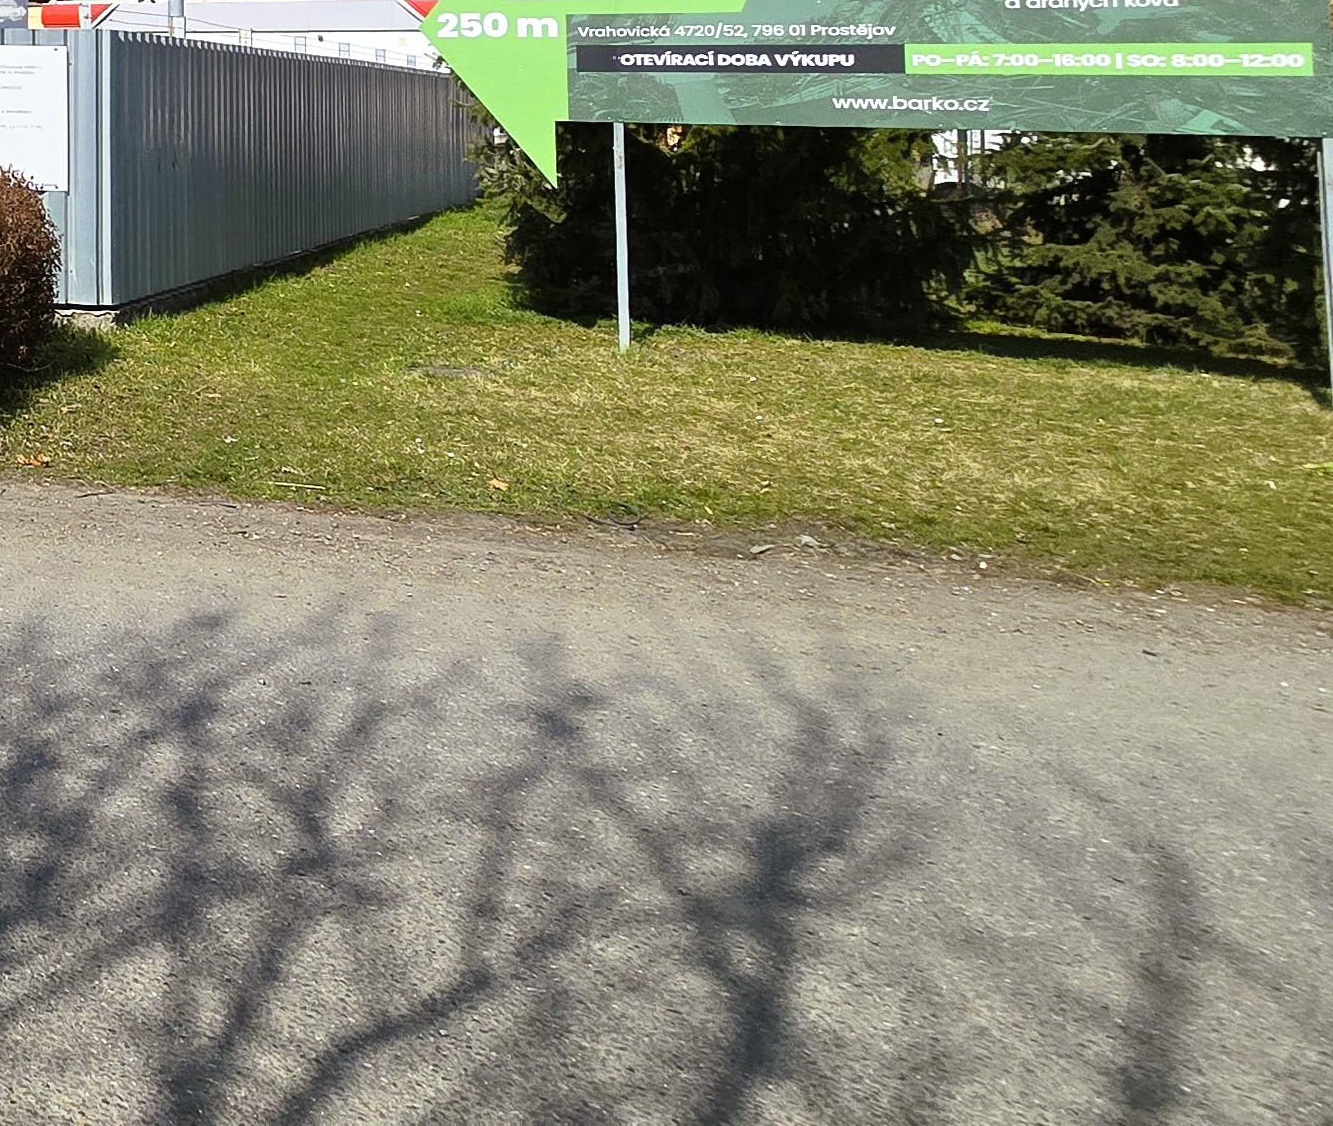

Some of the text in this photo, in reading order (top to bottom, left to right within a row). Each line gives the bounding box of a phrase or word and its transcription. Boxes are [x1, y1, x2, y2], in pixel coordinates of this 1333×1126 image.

[436, 12, 559, 39] 250 m
[577, 23, 897, 40] Vrahovická 4720/52, 796 01 Prostějov
[619, 51, 856, 67] OTEVÍRACÍ DOBA VÝKUPU
[1127, 53, 1167, 68] SO:
[831, 94, 991, 113] www.barko.cz
